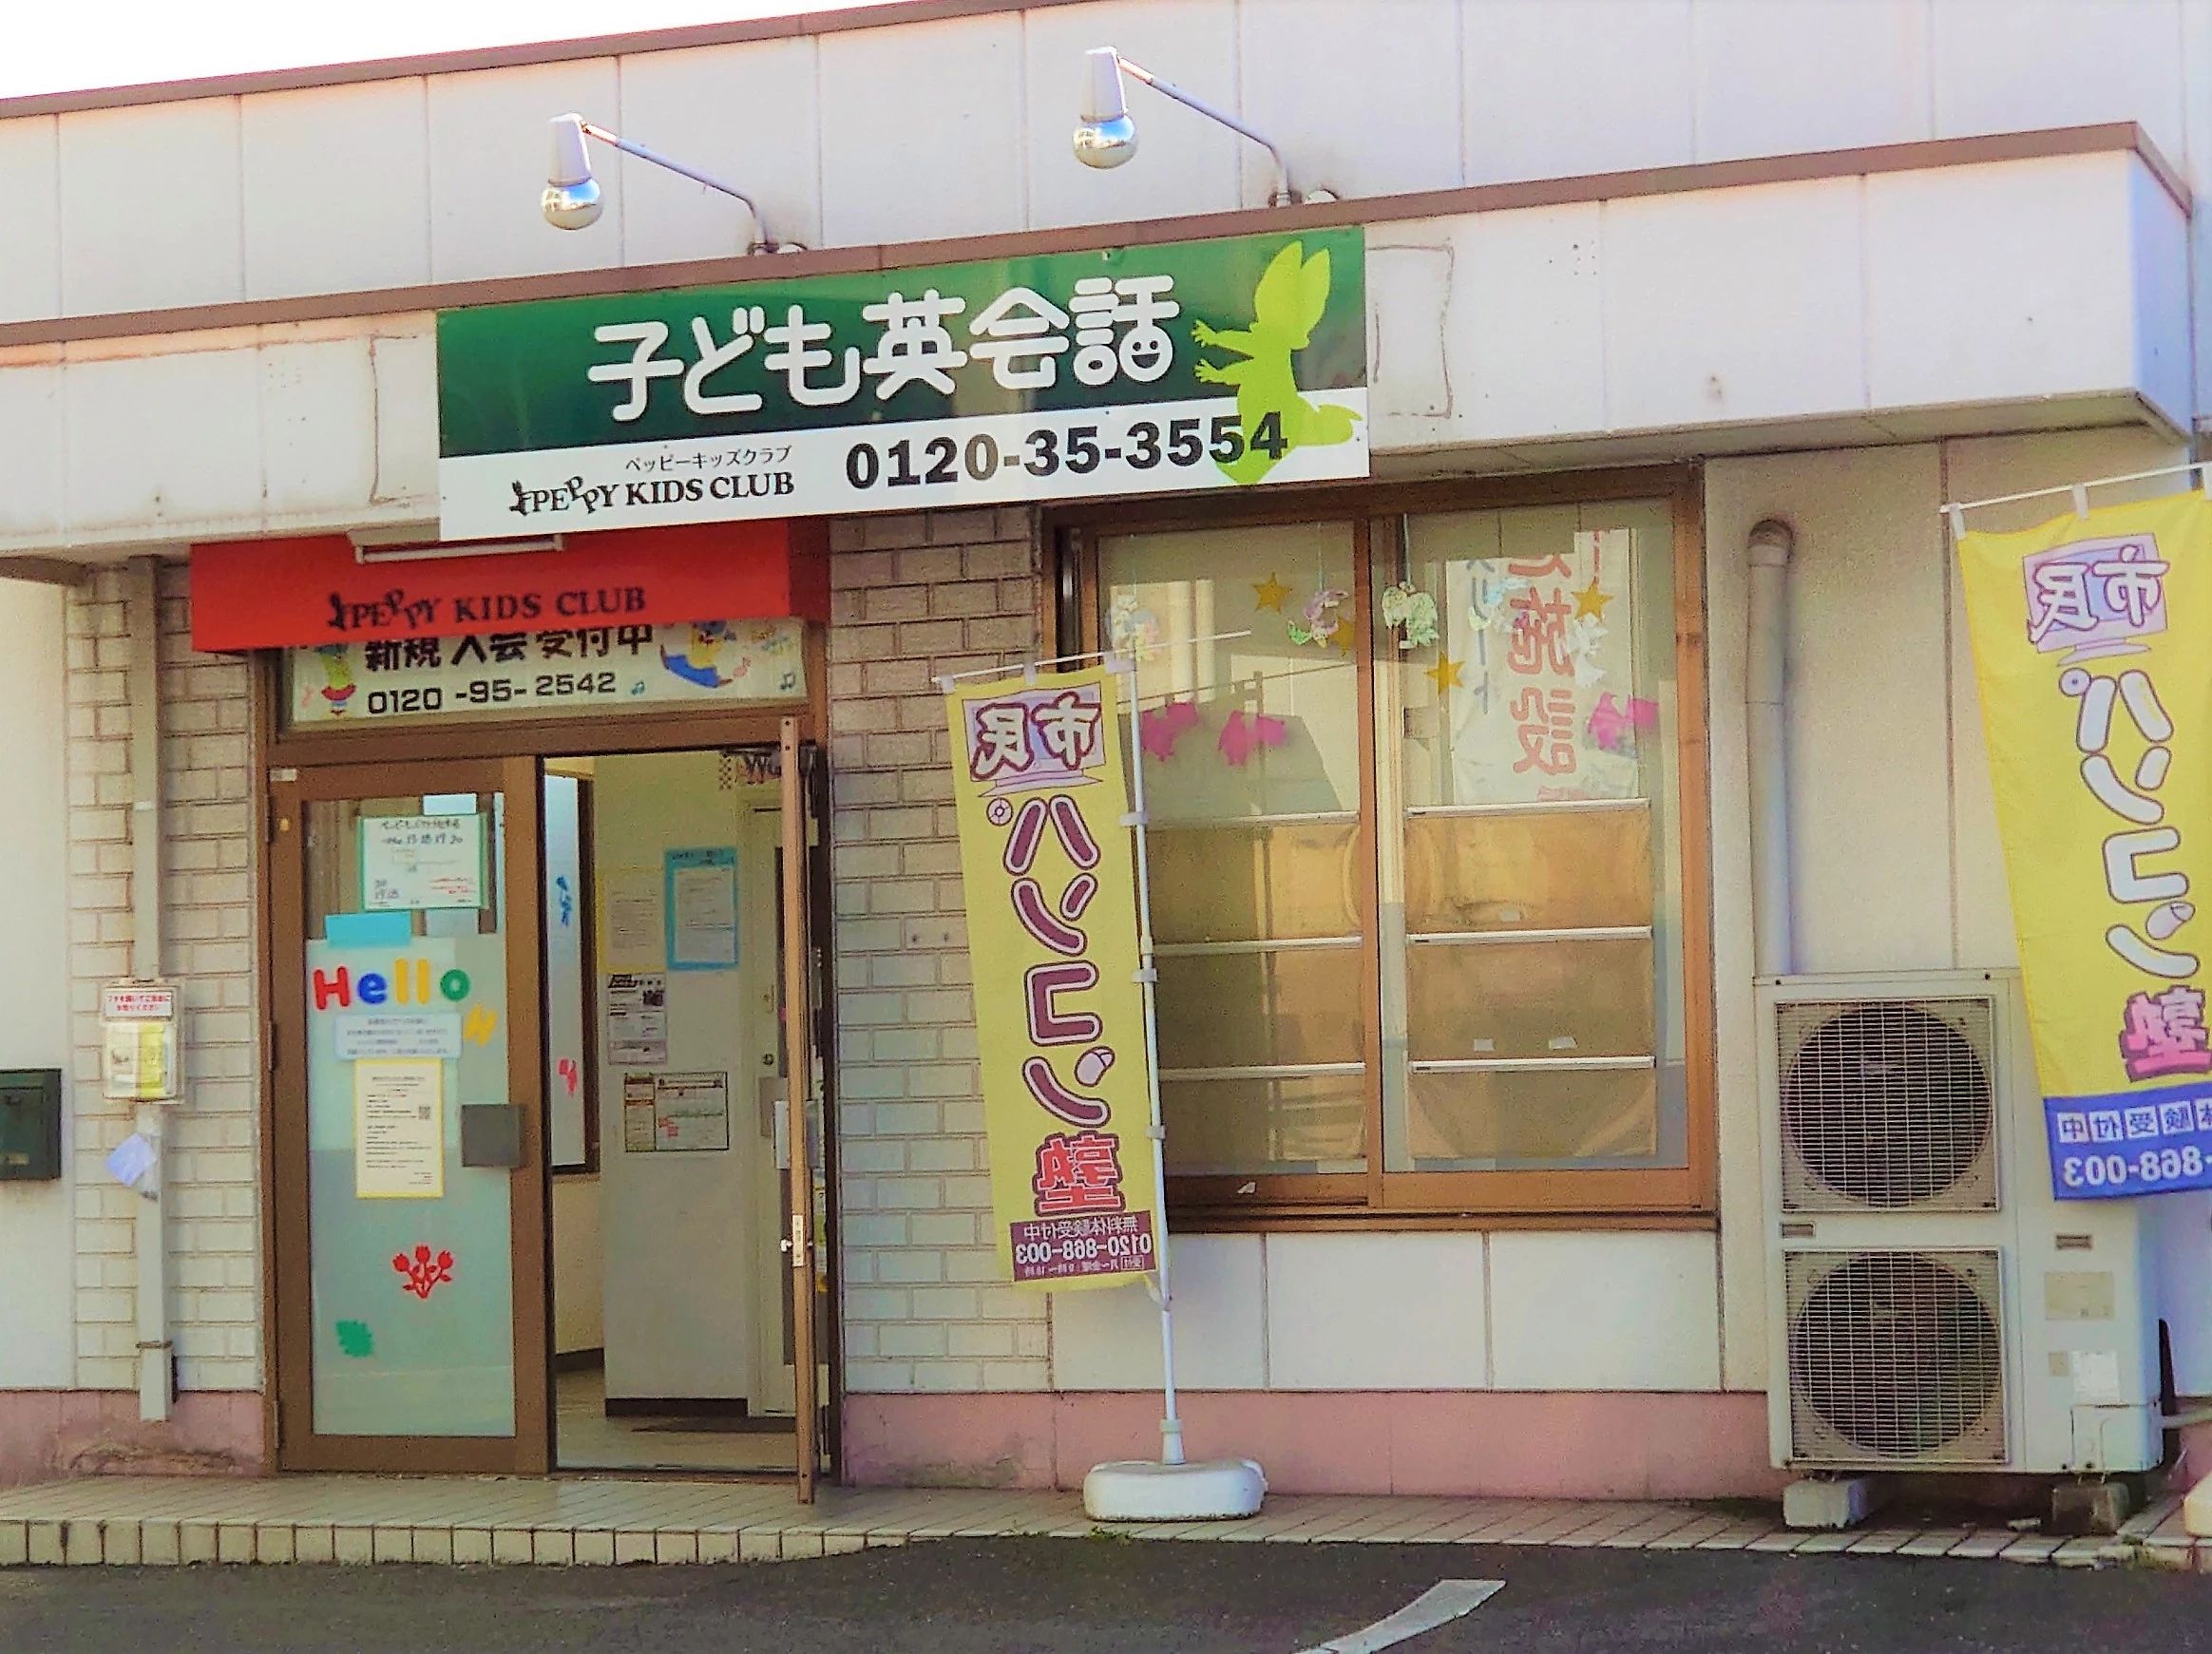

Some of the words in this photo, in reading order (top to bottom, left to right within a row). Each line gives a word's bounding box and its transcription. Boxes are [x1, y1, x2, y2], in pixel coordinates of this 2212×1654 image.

[588, 274, 1179, 423] 子ども英会話
[626, 446, 792, 471] ペッピーキッズクラブ
[846, 411, 1287, 489] 0120-35-3554
[532, 475, 619, 514] PEPPY
[626, 478, 703, 505] KIDS
[711, 471, 794, 499] CLUB
[352, 589, 440, 629] PEPPY
[455, 593, 542, 622] KIDS
[557, 587, 645, 617] CLUB
[313, 957, 471, 1011] Hello
